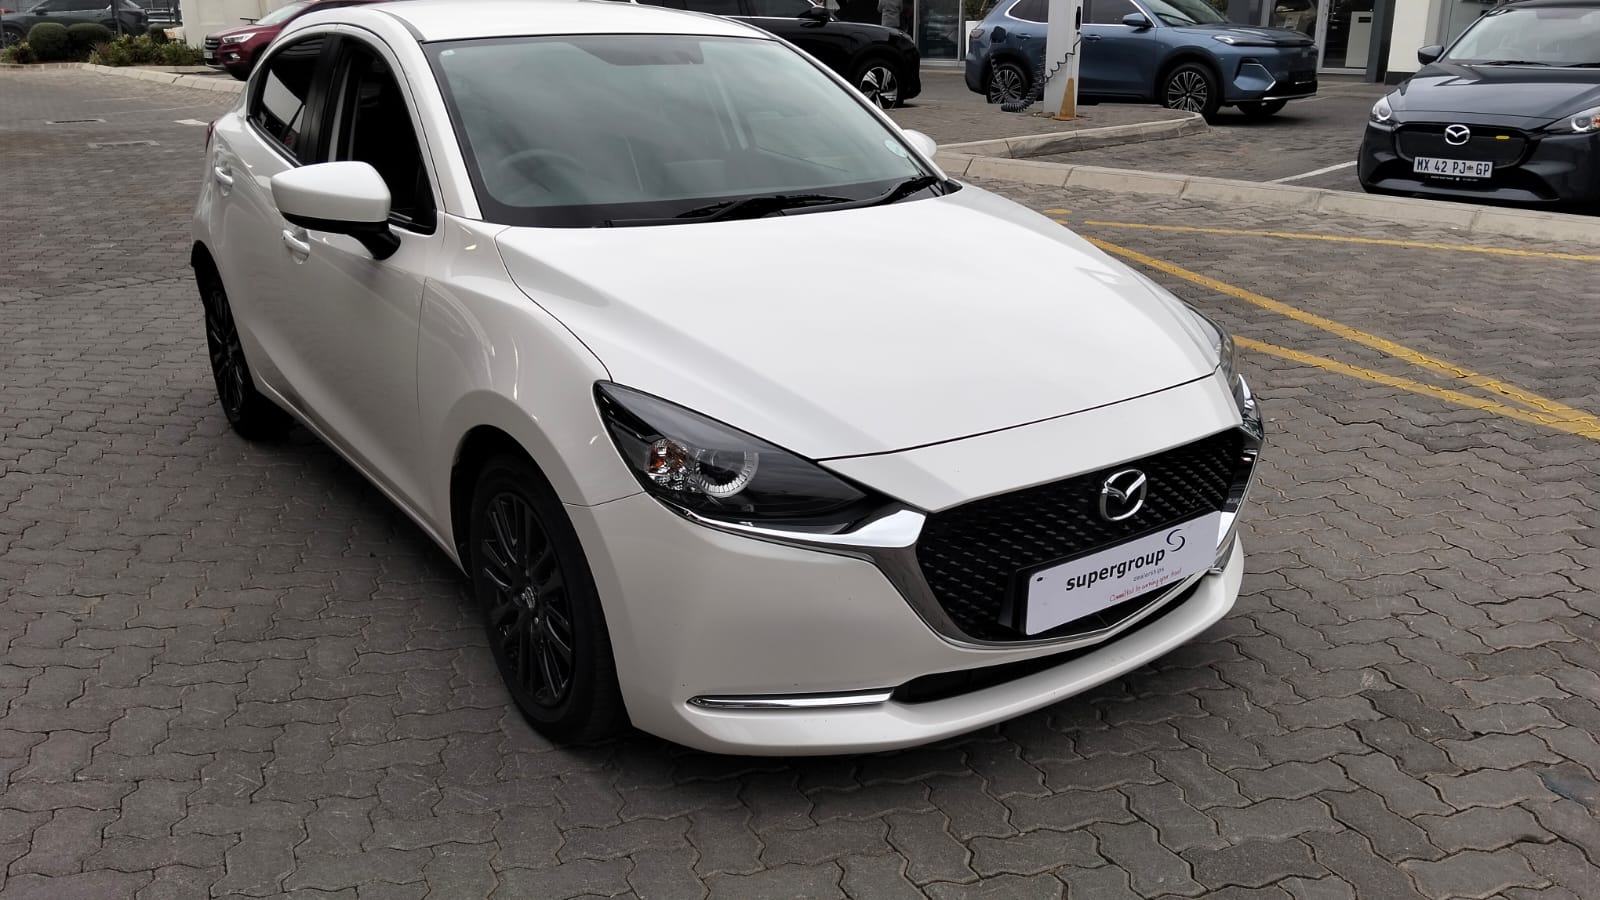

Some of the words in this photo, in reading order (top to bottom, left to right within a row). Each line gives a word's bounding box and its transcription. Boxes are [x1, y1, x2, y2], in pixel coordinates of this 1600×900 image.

[1434, 160, 1447, 173] 42
[1452, 162, 1467, 174] PJ
[1476, 163, 1490, 176] GP
[1066, 549, 1165, 591] supergroup
